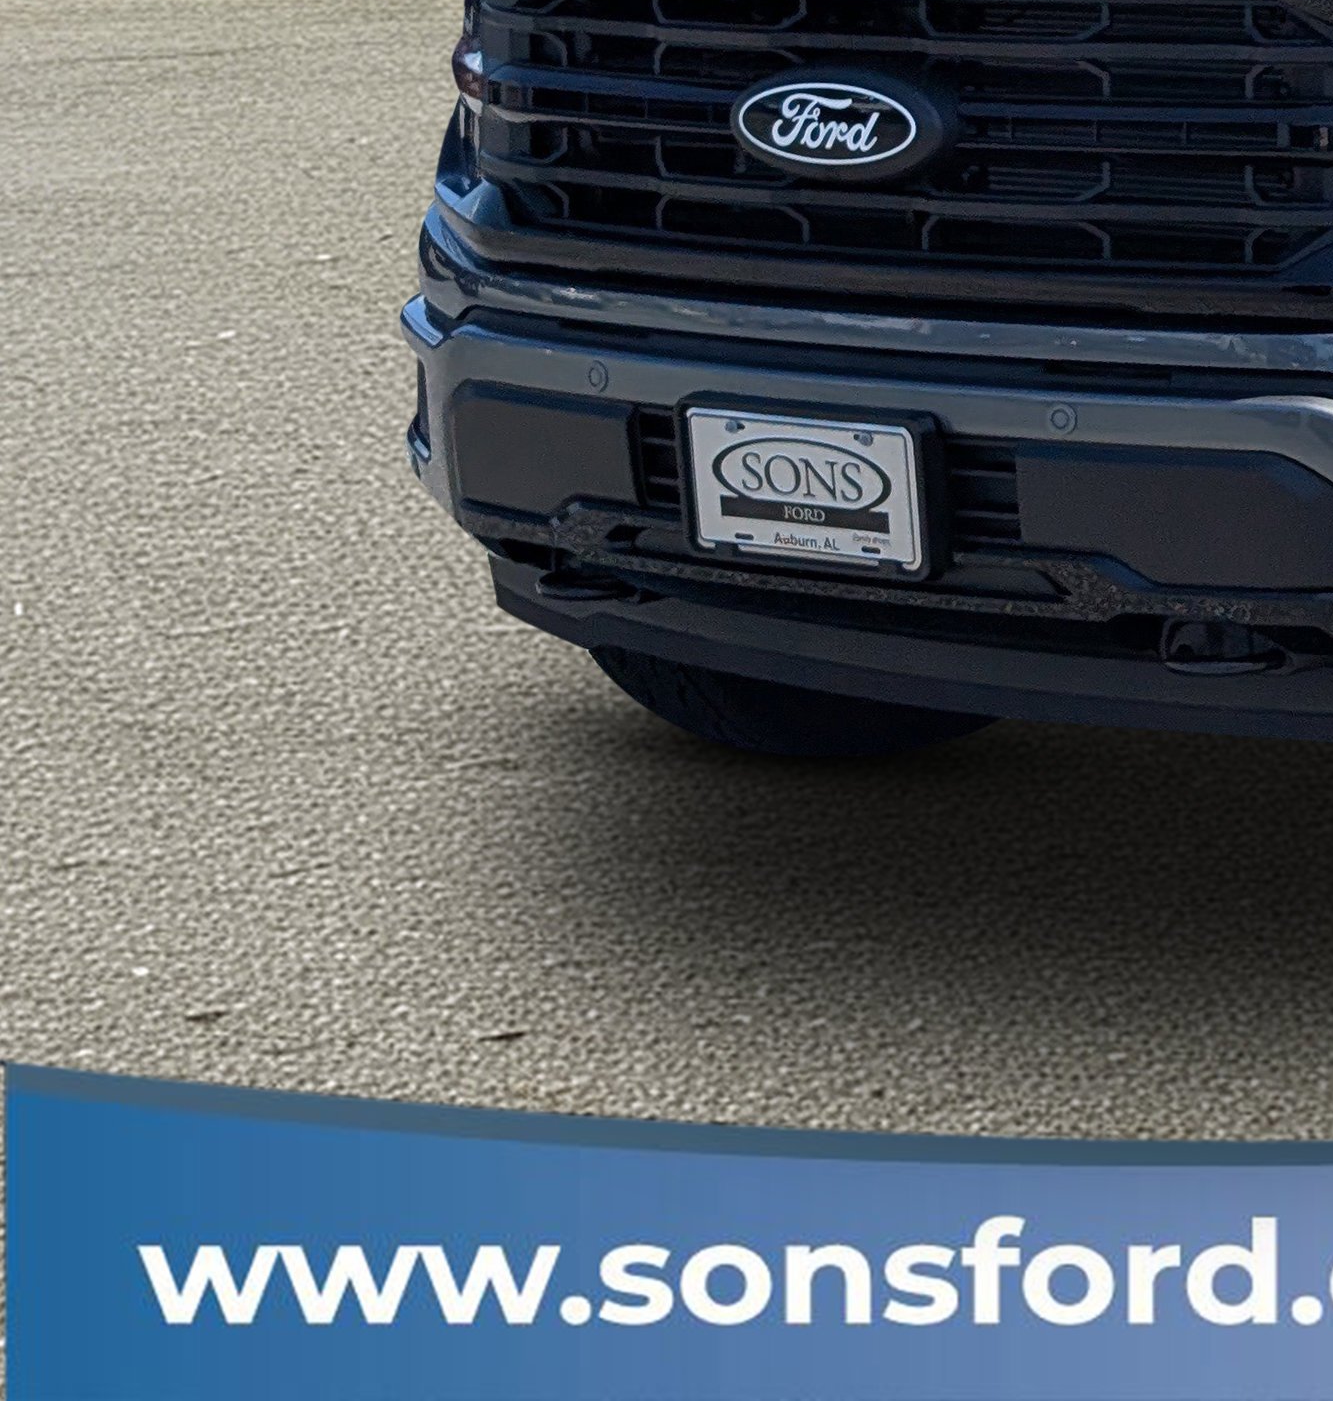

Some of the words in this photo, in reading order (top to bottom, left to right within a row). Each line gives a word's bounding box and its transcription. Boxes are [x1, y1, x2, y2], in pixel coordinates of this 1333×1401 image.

[771, 92, 880, 152] Ford
[741, 451, 864, 503] SONS
[783, 505, 826, 522] FORD
[824, 538, 841, 551] AL
